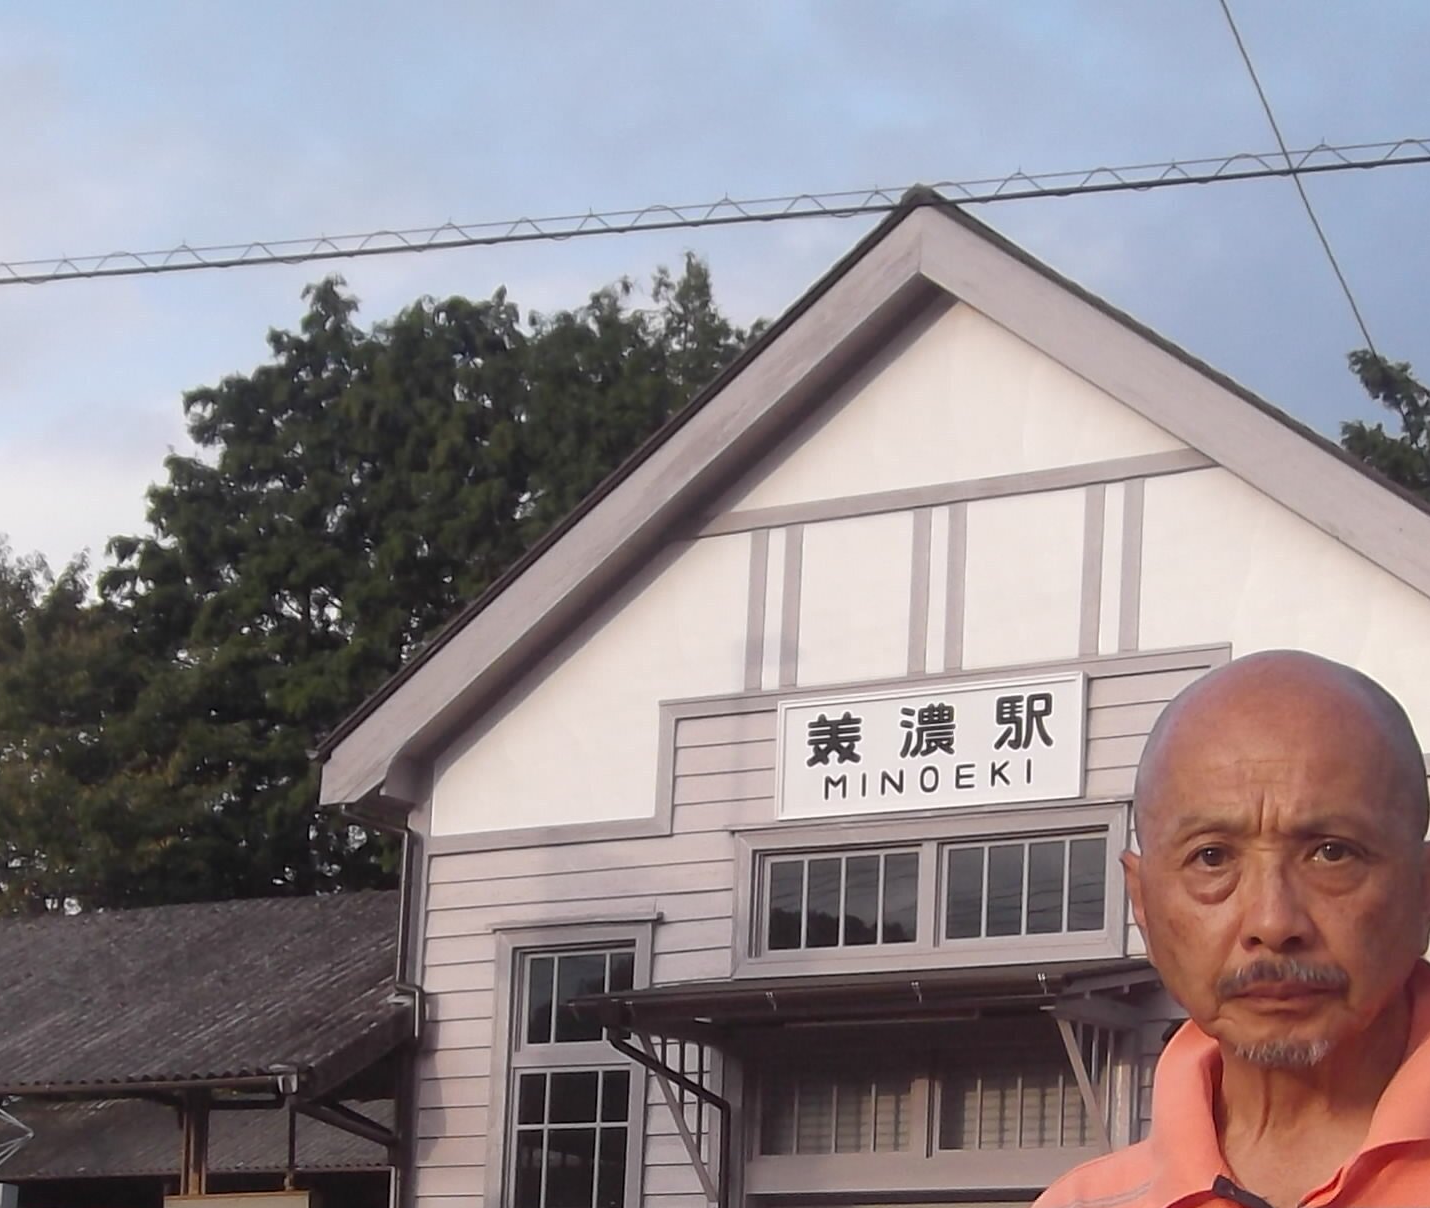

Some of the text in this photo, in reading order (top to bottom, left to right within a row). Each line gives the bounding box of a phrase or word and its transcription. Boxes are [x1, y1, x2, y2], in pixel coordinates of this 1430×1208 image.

[806, 692, 1054, 767] 美濃駅
[824, 758, 1032, 800] MINOEKI
